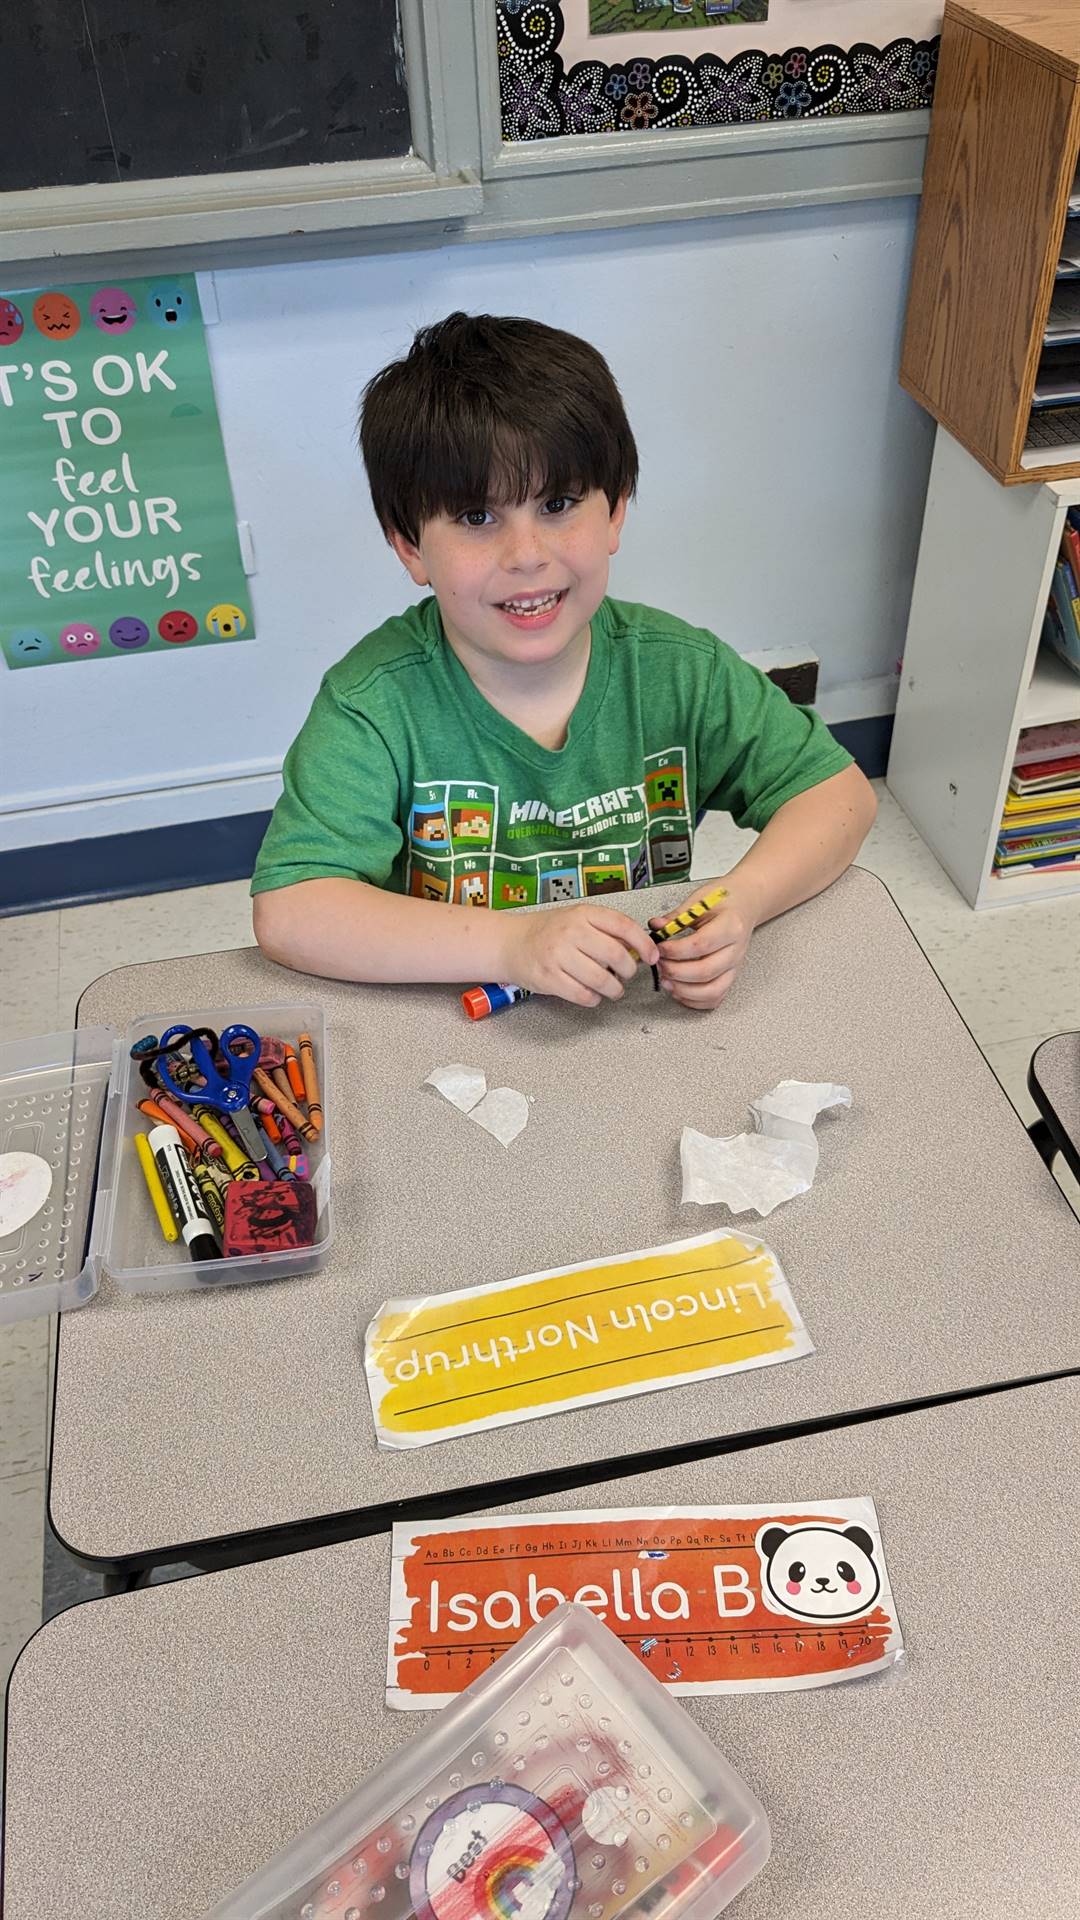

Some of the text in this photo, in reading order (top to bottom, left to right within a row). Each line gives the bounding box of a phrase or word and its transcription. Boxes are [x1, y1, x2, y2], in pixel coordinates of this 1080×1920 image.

[0, 350, 177, 406] T'S OK
[43, 407, 122, 449] TO
[52, 452, 140, 503] feel
[27, 496, 182, 548] YOUR
[27, 550, 203, 598] feelings
[507, 825, 569, 840] OVERWORLD
[572, 814, 619, 840] PERIODIC
[508, 783, 646, 828] MINECRAFT
[395, 1282, 767, 1382] Lincoln Northrup
[425, 1550, 438, 1558] Aa
[443, 1549, 454, 1557] Bb
[477, 1546, 488, 1555] Dd
[493, 1545, 504, 1554] Ee
[510, 1544, 520, 1552] Ff
[526, 1543, 537, 1553] Gg
[543, 1542, 554, 1550] Hh
[572, 1540, 582, 1549] Jj
[586, 1539, 597, 1548] Kk
[616, 1538, 632, 1546] Mm
[637, 1537, 648, 1545] Nn
[653, 1536, 665, 1545] Oo
[671, 1536, 681, 1546] Pp
[687, 1535, 700, 1546] Qq
[704, 1535, 714, 1543] Rr
[720, 1534, 731, 1543] Ss
[736, 1533, 746, 1542] Tt
[430, 1567, 690, 1633] Isabella
[424, 1660, 430, 1671] 0
[466, 1658, 471, 1668] 2
[665, 1647, 671, 1657] 11
[686, 1646, 694, 1656] 12
[708, 1645, 716, 1655] 13
[729, 1644, 738, 1655] 14
[751, 1643, 760, 1653] 15
[773, 1642, 782, 1652] 16
[795, 1641, 803, 1652] 17
[816, 1640, 826, 1651] 18
[838, 1639, 848, 1649] 19
[859, 1636, 871, 1646] 20
[446, 1829, 487, 1884] Best
